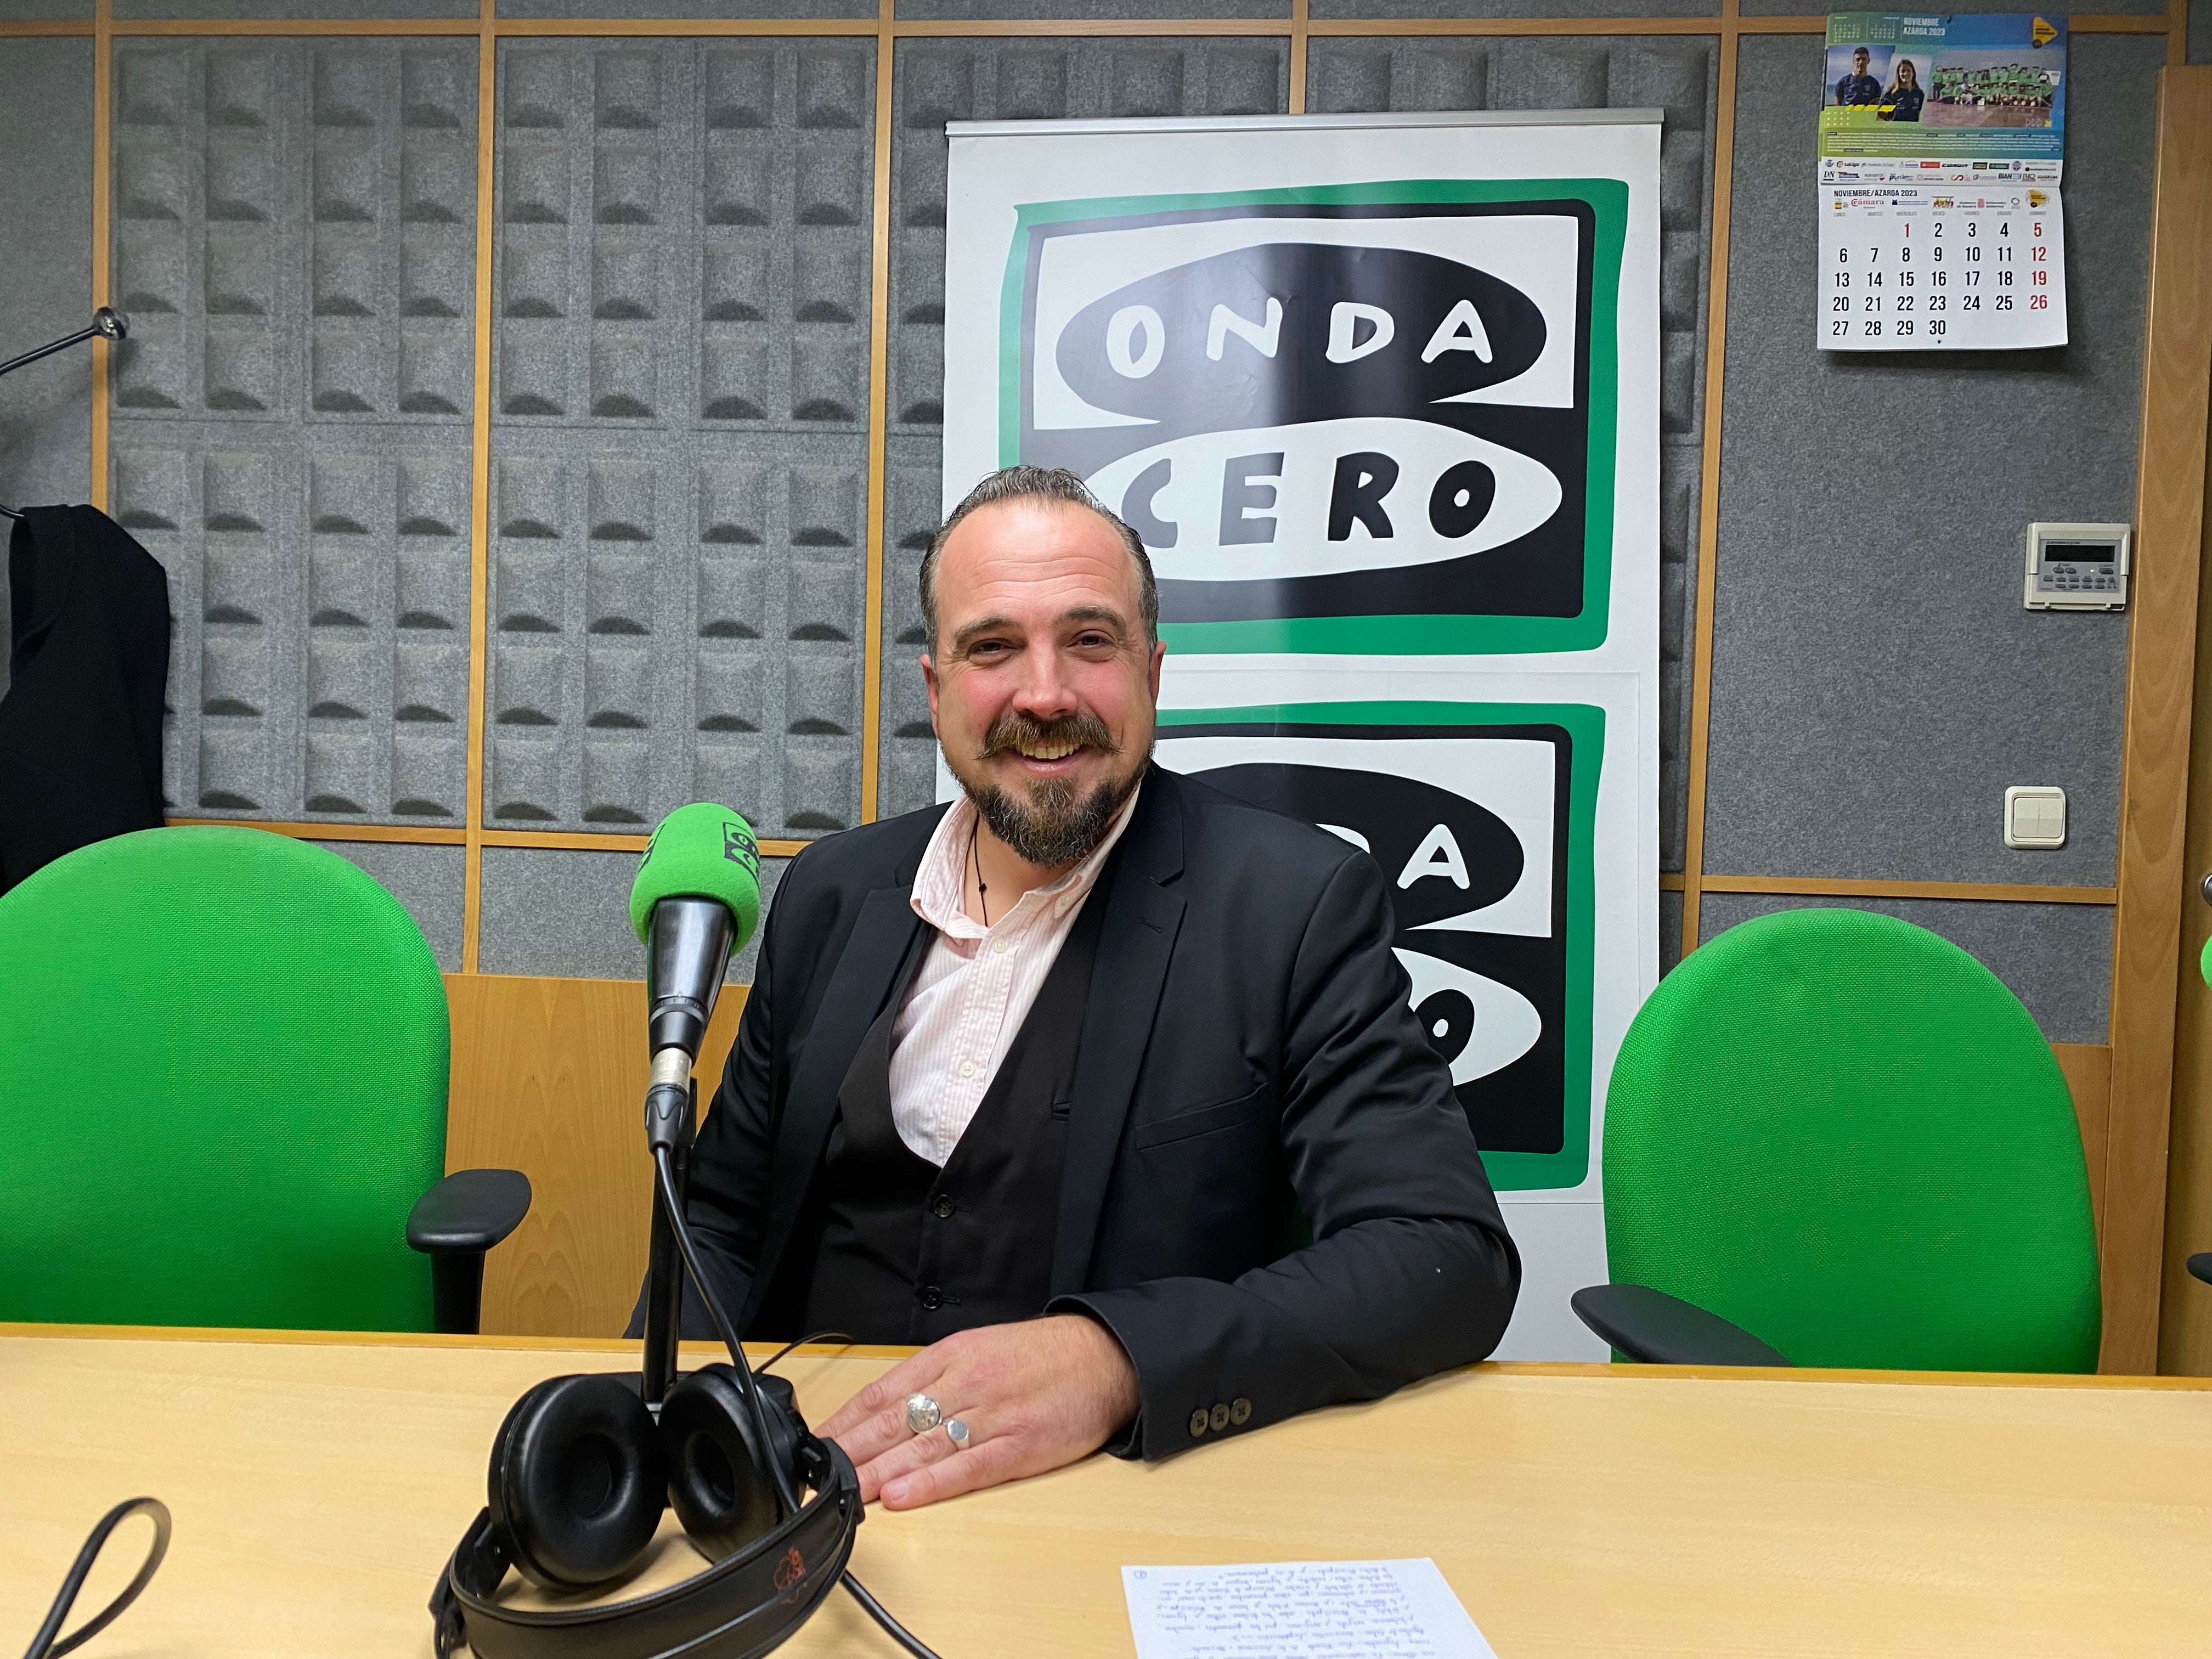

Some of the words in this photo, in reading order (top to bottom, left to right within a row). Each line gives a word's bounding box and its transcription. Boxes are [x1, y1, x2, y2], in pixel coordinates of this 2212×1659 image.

[1904, 18, 1939, 26] NOVIEMBRE
[1852, 198, 1884, 207] Cámara
[1904, 223, 1909, 237] 1
[1934, 223, 1943, 237] 2
[1968, 223, 1976, 237] 3
[2000, 223, 2009, 237] 4
[2034, 223, 2042, 237] 5
[1839, 249, 1848, 262] 6
[1870, 248, 1878, 262] 7
[1902, 247, 1910, 262] 8
[1934, 247, 1942, 261] 9
[1965, 247, 1980, 261] 10
[1997, 247, 2012, 261] 11
[2031, 247, 2046, 261] 12
[1835, 273, 1850, 287] 13
[1867, 272, 1883, 287] 14
[1899, 272, 1914, 286] 15
[1931, 272, 1946, 286] 16
[1965, 271, 1980, 285] 17
[1997, 271, 2013, 285] 18
[2032, 271, 2047, 285] 19
[1833, 297, 1849, 311] 20
[1865, 297, 1881, 311] 21
[1897, 296, 1914, 311] 22
[1929, 296, 1946, 310] 23
[1963, 296, 1980, 310] 24
[1996, 296, 2013, 310] 25
[2030, 295, 2047, 309] 26
[1832, 321, 1849, 335] 27
[1865, 321, 1882, 335] 28
[1897, 320, 1914, 335] 29
[1929, 320, 1946, 335] 30
[1105, 297, 1493, 379] ONDA
[1121, 452, 1496, 549] CERO
